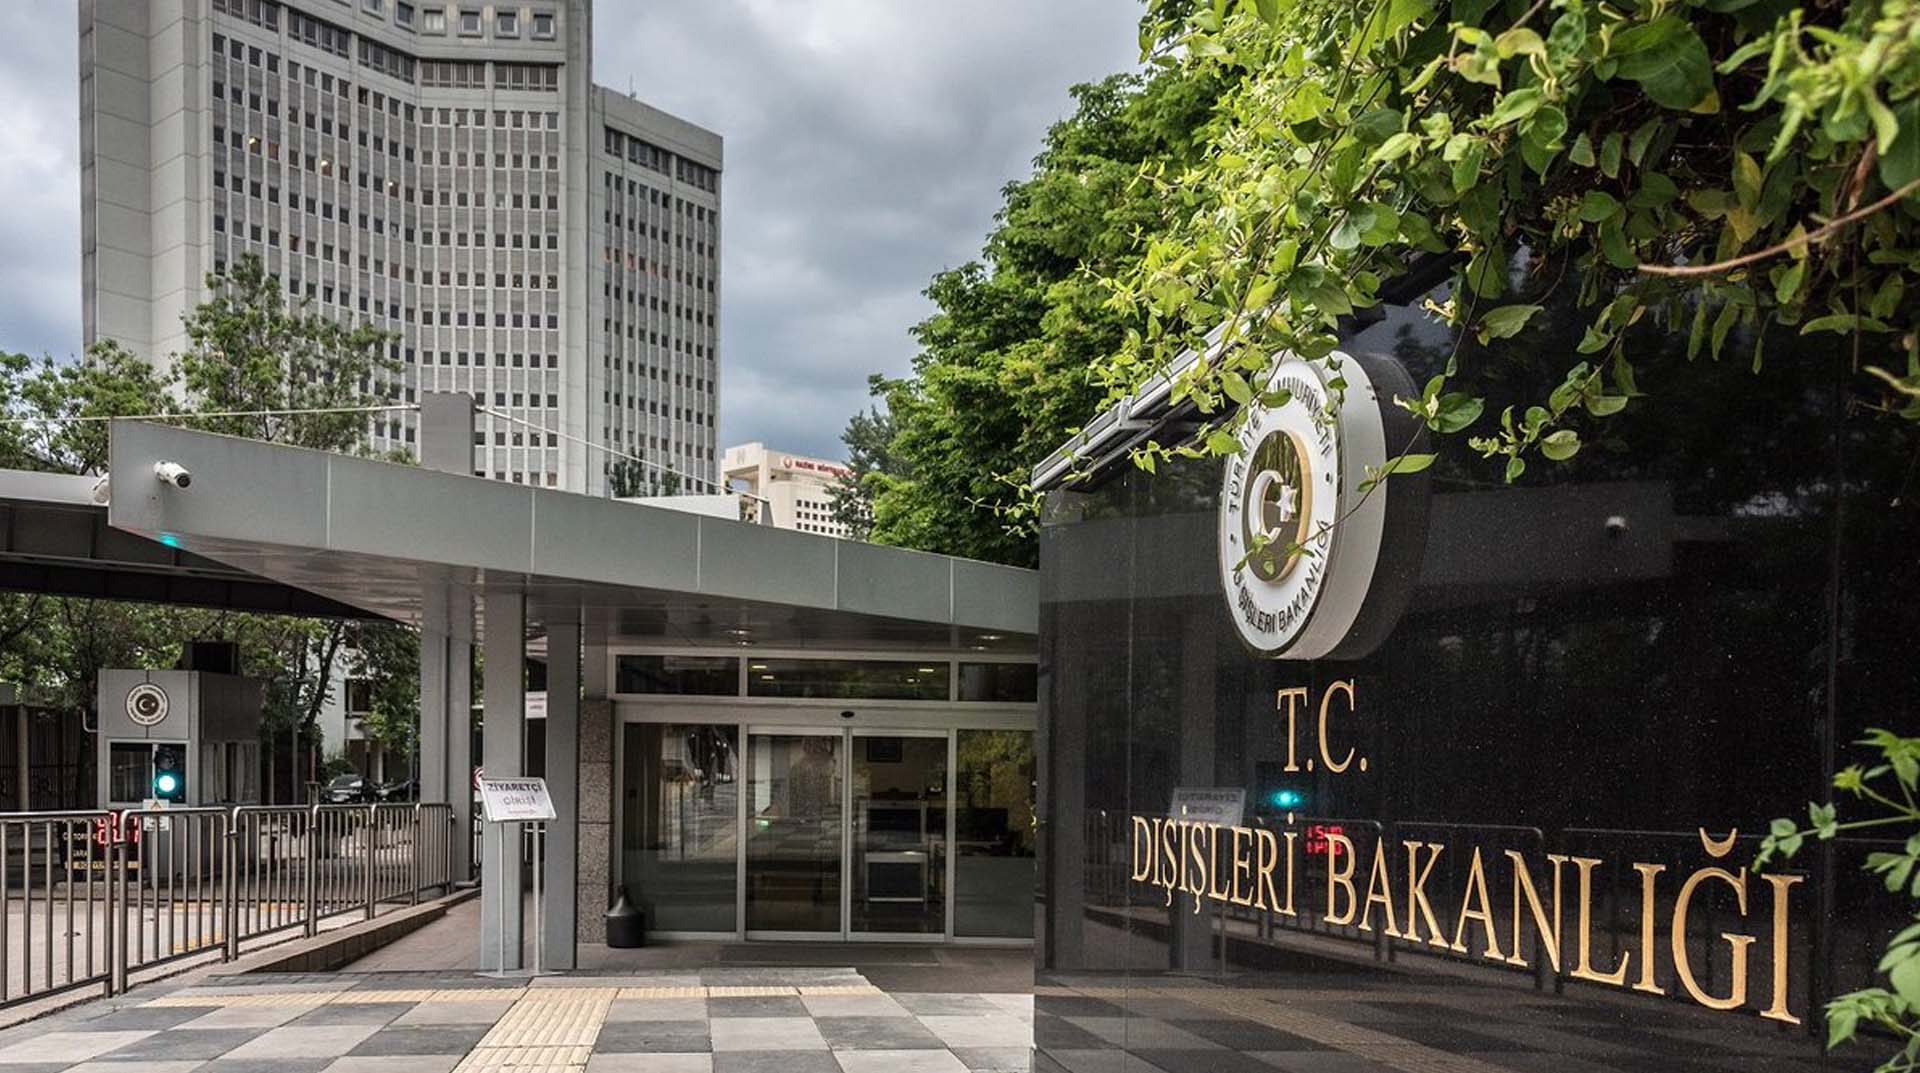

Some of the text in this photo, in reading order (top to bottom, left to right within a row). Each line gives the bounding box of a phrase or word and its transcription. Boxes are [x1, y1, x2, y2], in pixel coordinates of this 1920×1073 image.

[1277, 679, 1368, 773] T.C.
[1132, 805, 1804, 1025] DIŞİŞLERİ BAKANLIĞI
